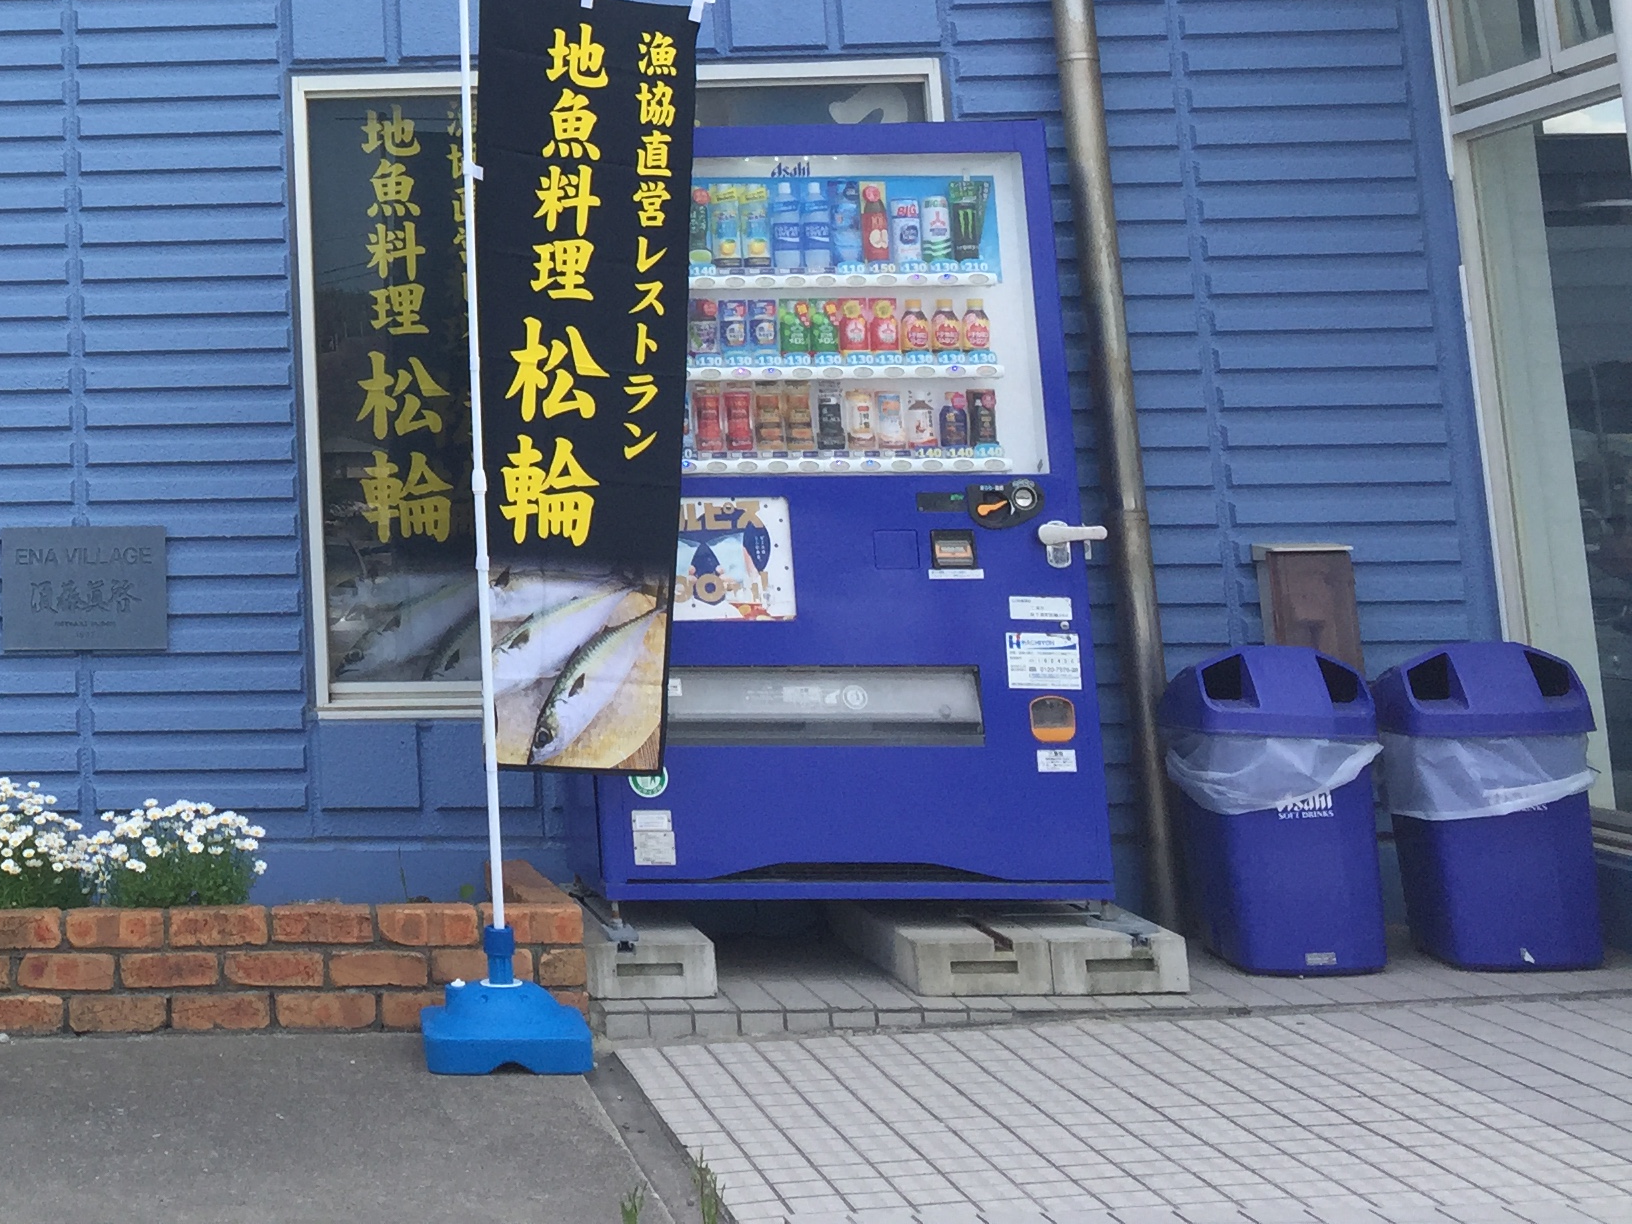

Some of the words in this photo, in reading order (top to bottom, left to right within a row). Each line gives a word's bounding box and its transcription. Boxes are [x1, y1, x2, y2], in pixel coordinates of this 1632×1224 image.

[622, 31, 678, 462] 漁協直営レストラン
[15, 548, 58, 566] ENA
[66, 547, 153, 566] VILLAGE
